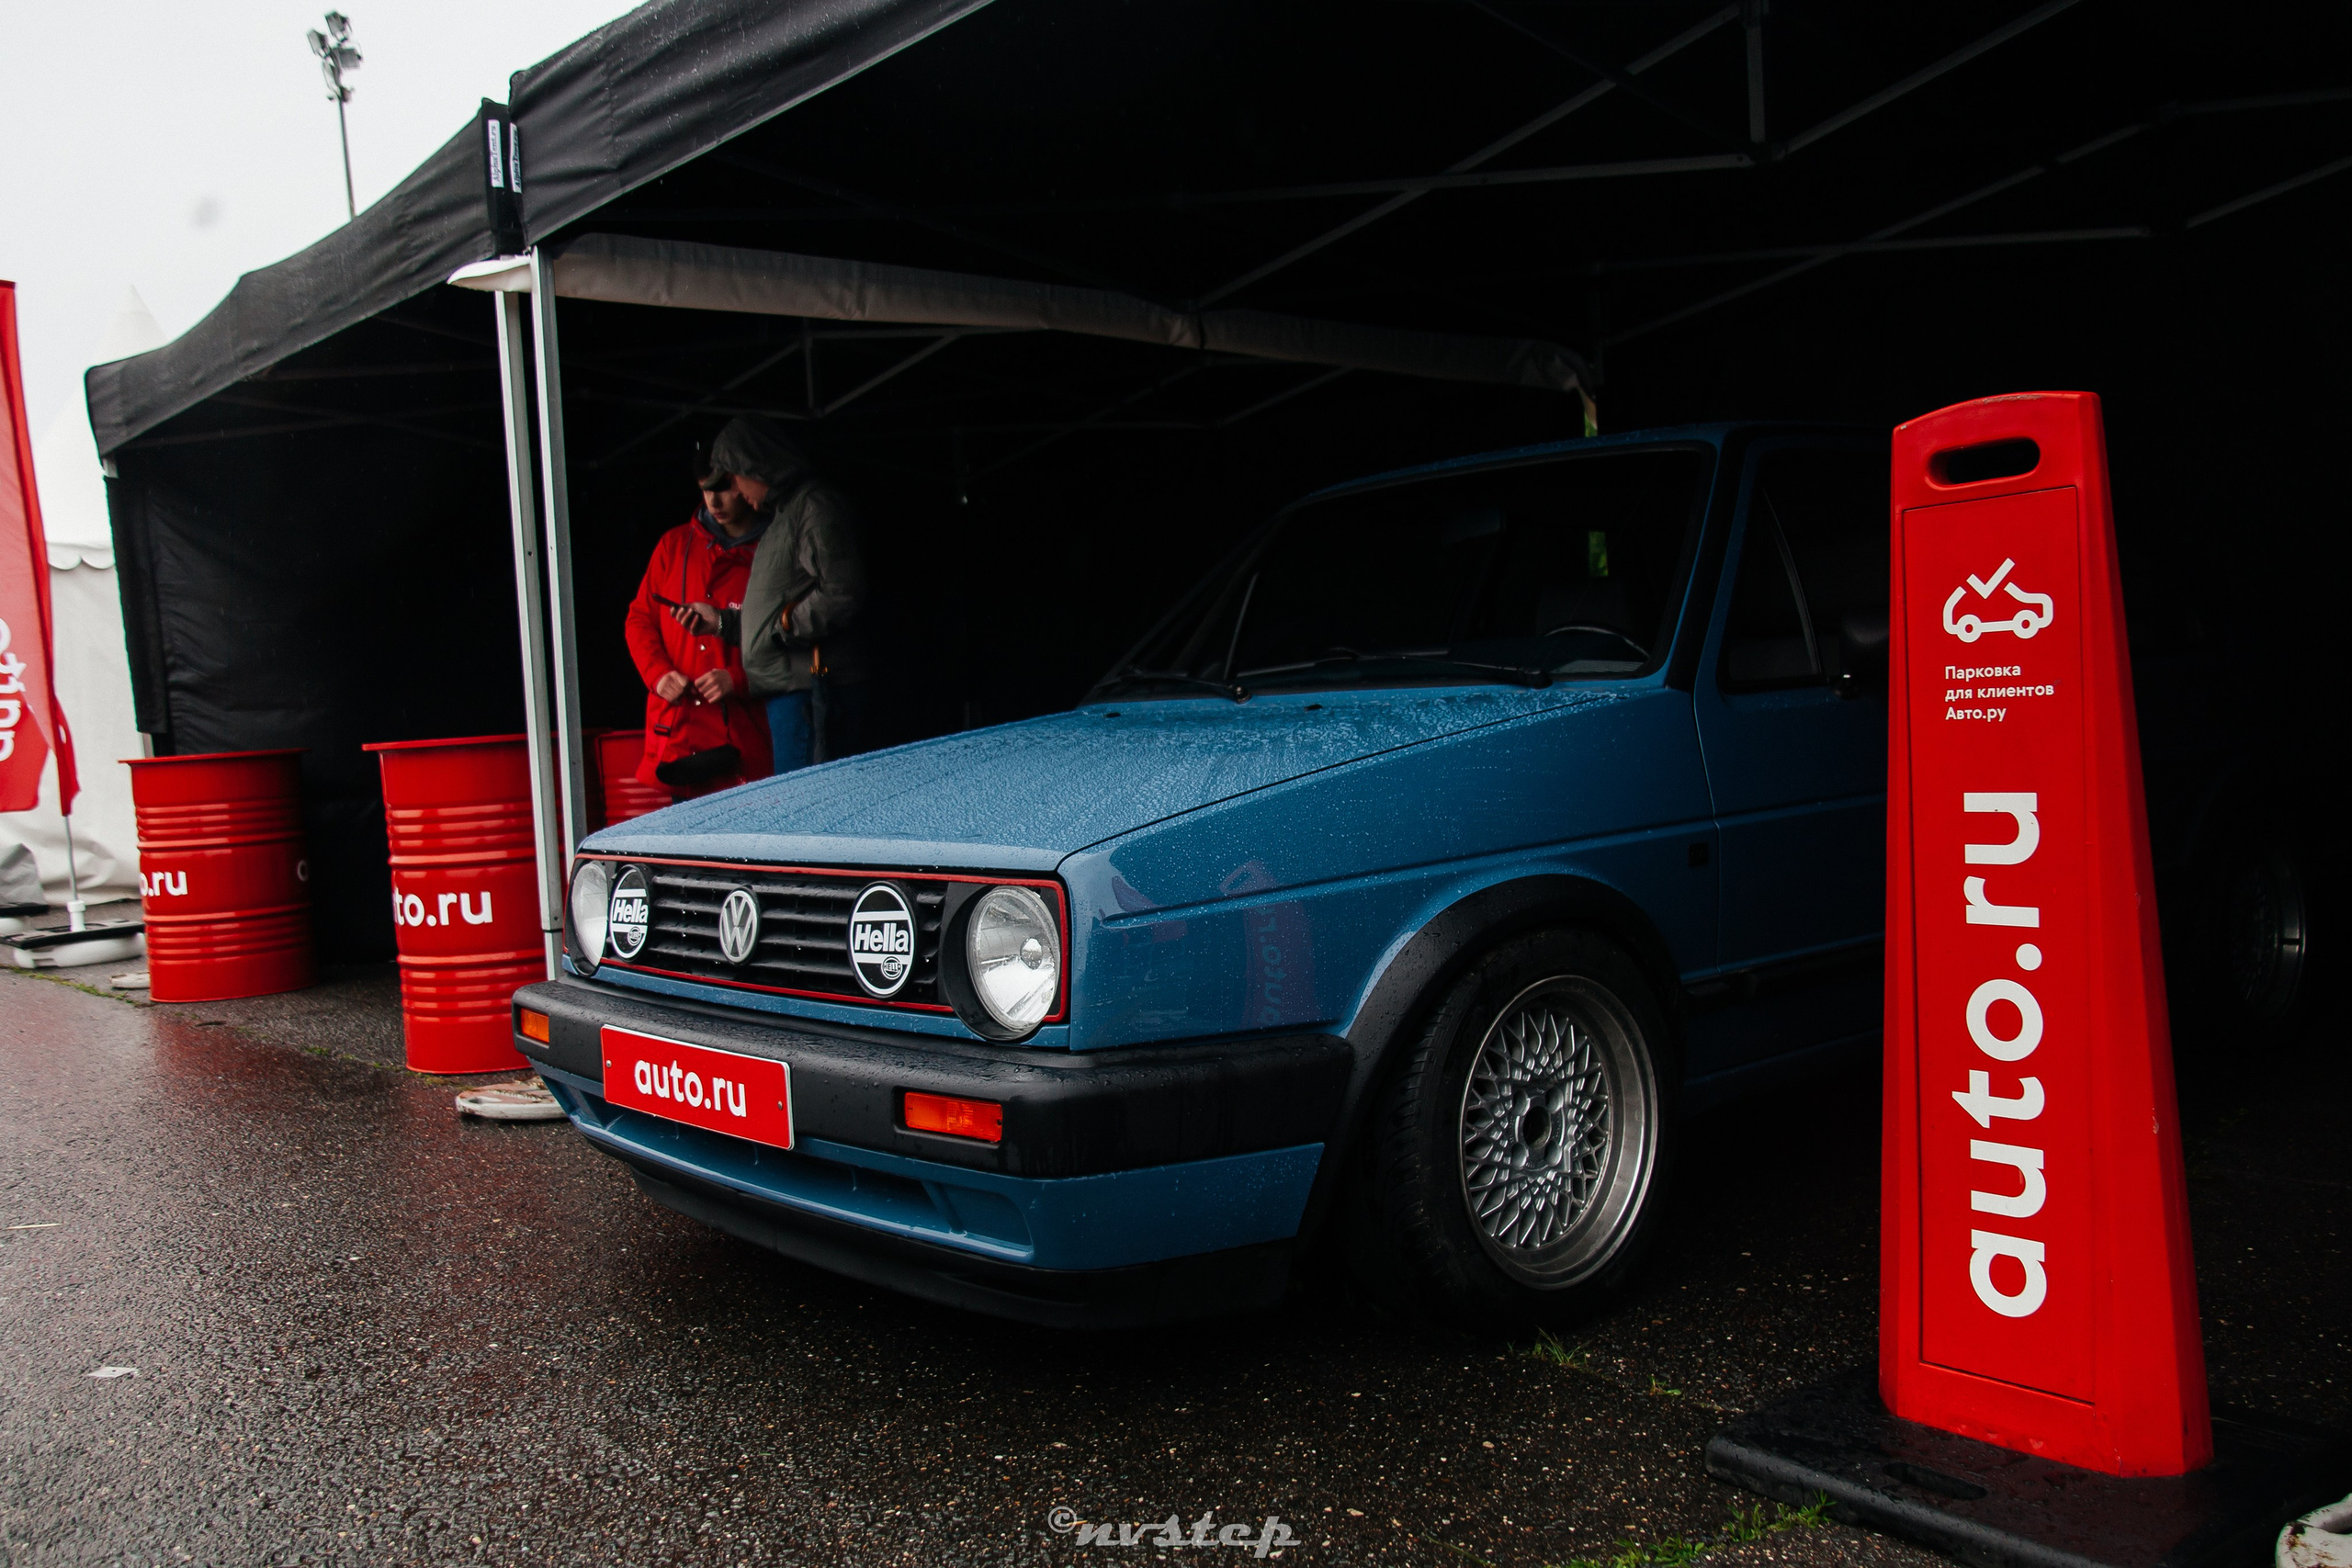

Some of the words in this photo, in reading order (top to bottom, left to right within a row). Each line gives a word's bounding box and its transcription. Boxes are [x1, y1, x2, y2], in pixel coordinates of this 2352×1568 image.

[1945, 665, 2021, 682] Парковка
[1945, 688, 1973, 702] для
[1977, 684, 2054, 699] клиентов
[1945, 706, 2007, 722] Авто.ру
[393, 887, 493, 927] to.ru
[614, 898, 649, 923] Hella
[854, 922, 909, 952] Hella
[1951, 792, 2048, 1318] auto.ru
[634, 1059, 747, 1118] auto.ru
